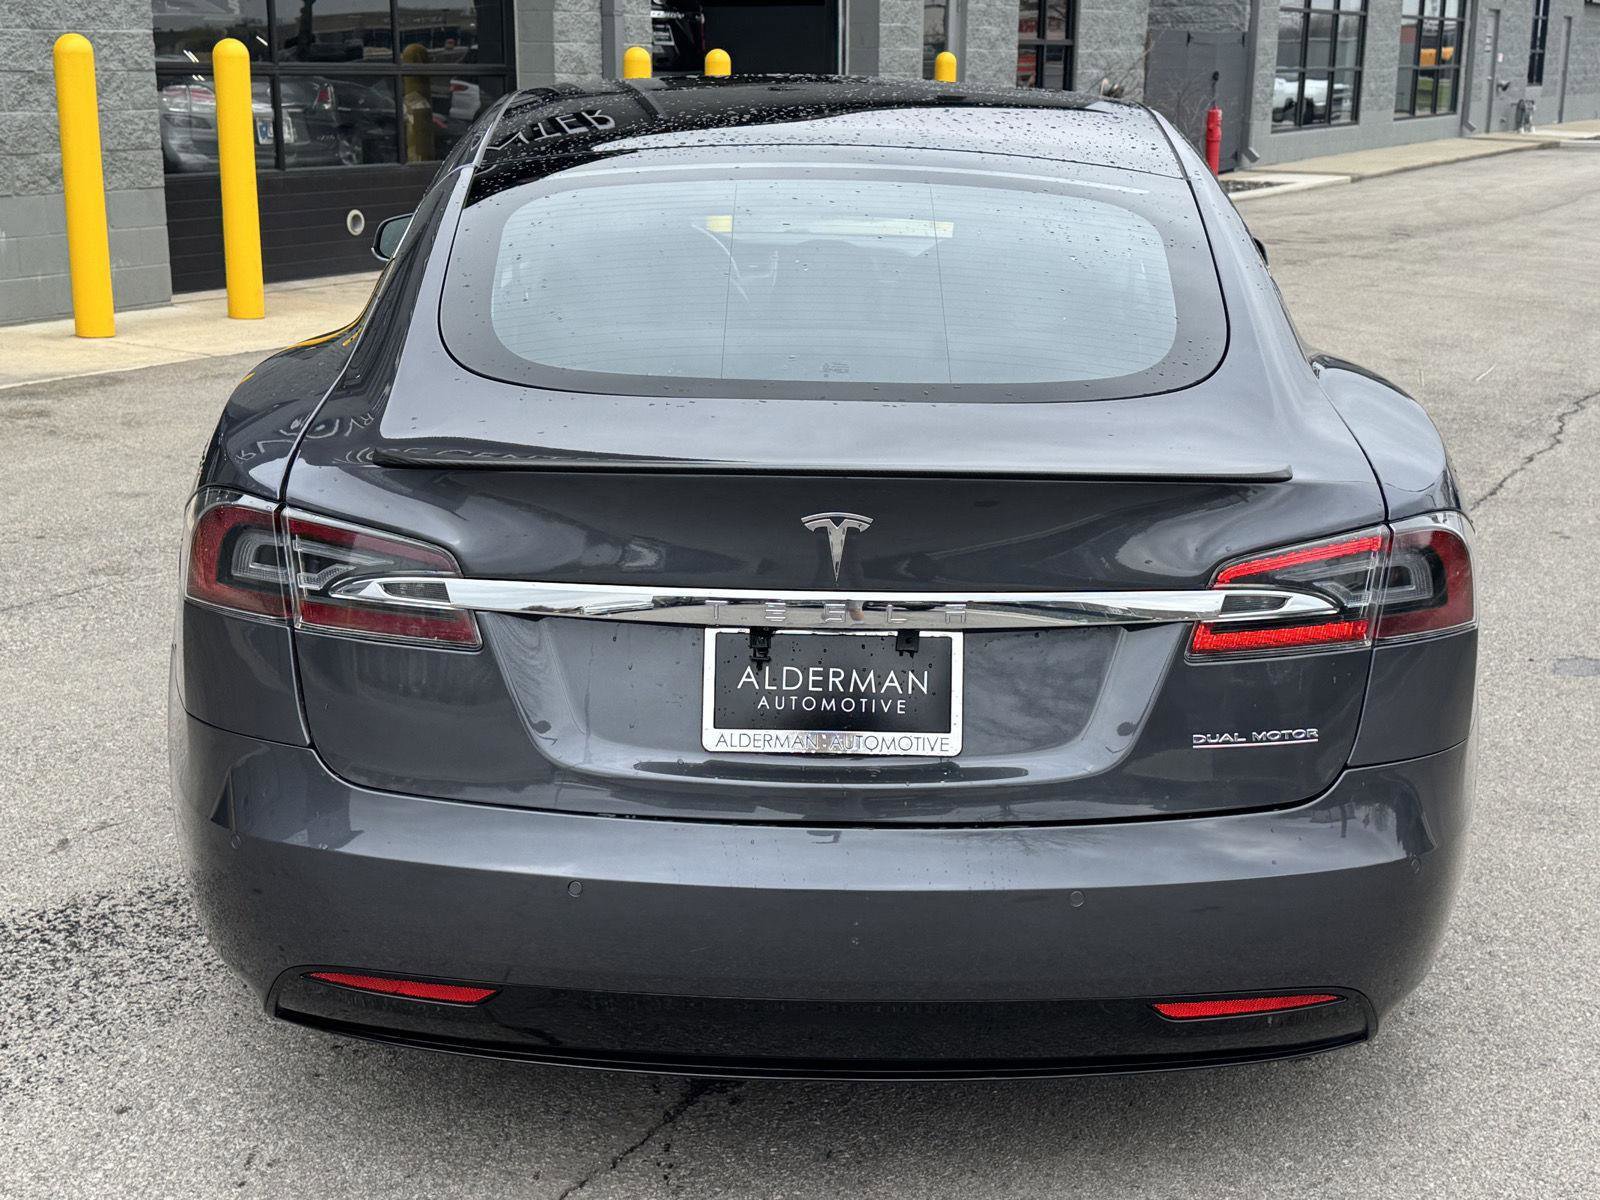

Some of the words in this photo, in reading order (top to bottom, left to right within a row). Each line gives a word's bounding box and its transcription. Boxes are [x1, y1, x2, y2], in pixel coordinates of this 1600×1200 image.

[705, 600, 968, 624] TESLA
[737, 666, 929, 695] ALDERMAN
[757, 696, 906, 714] AUTOMOTIVE
[715, 733, 818, 749] ALDERMAN
[829, 734, 950, 752] AUTOMOTIVE
[1192, 732, 1247, 744] DUAL
[1252, 728, 1319, 742] MOTOR
